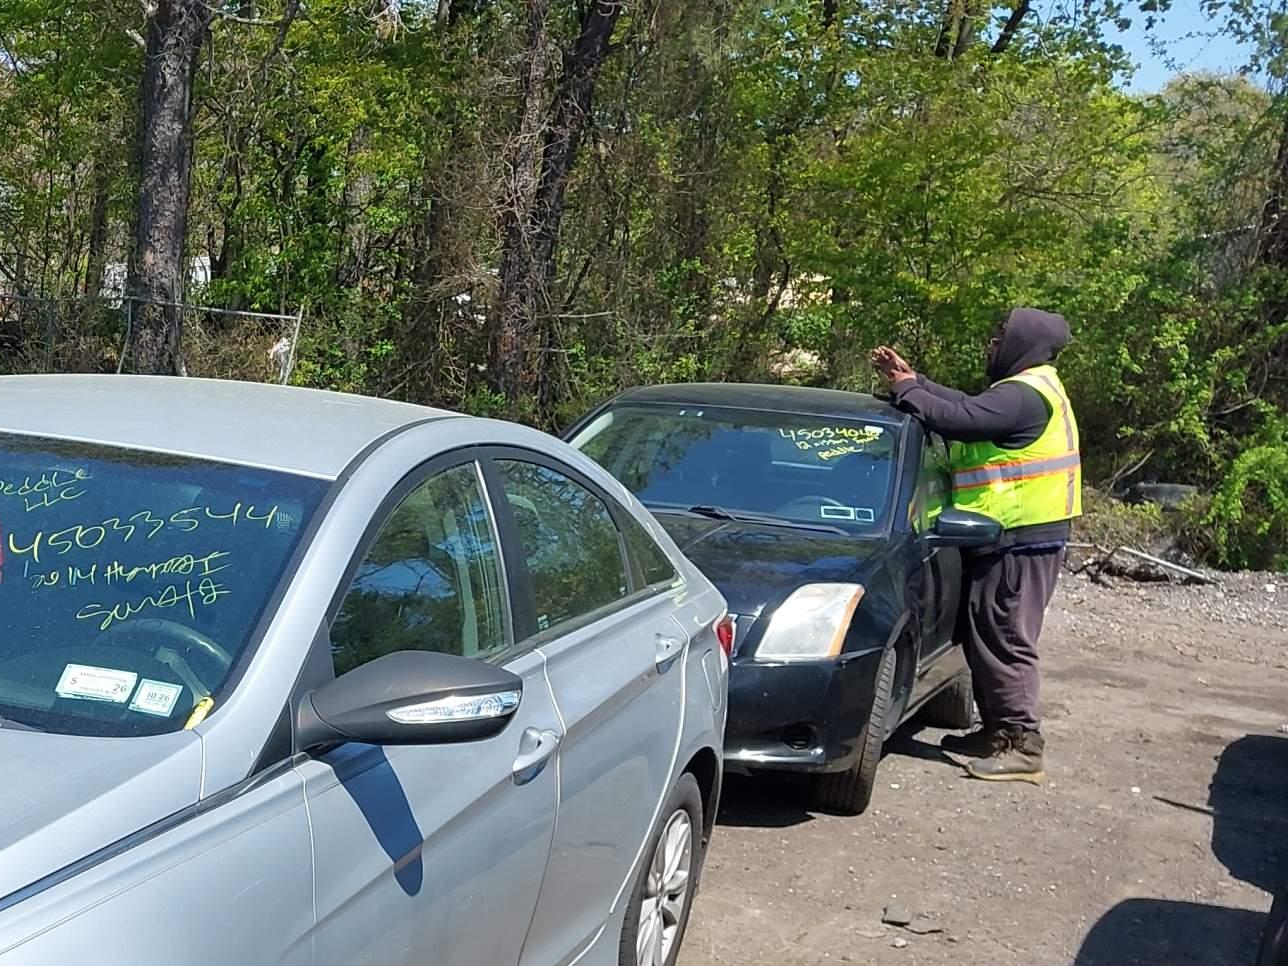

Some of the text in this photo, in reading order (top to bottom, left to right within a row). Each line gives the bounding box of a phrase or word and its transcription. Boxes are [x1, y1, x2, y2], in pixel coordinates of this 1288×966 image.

[24, 486, 88, 512] LLC
[9, 502, 279, 563] 45033544
[69, 677, 78, 686] 5
[112, 683, 128, 694] 26
[146, 690, 171, 702] 10 26
